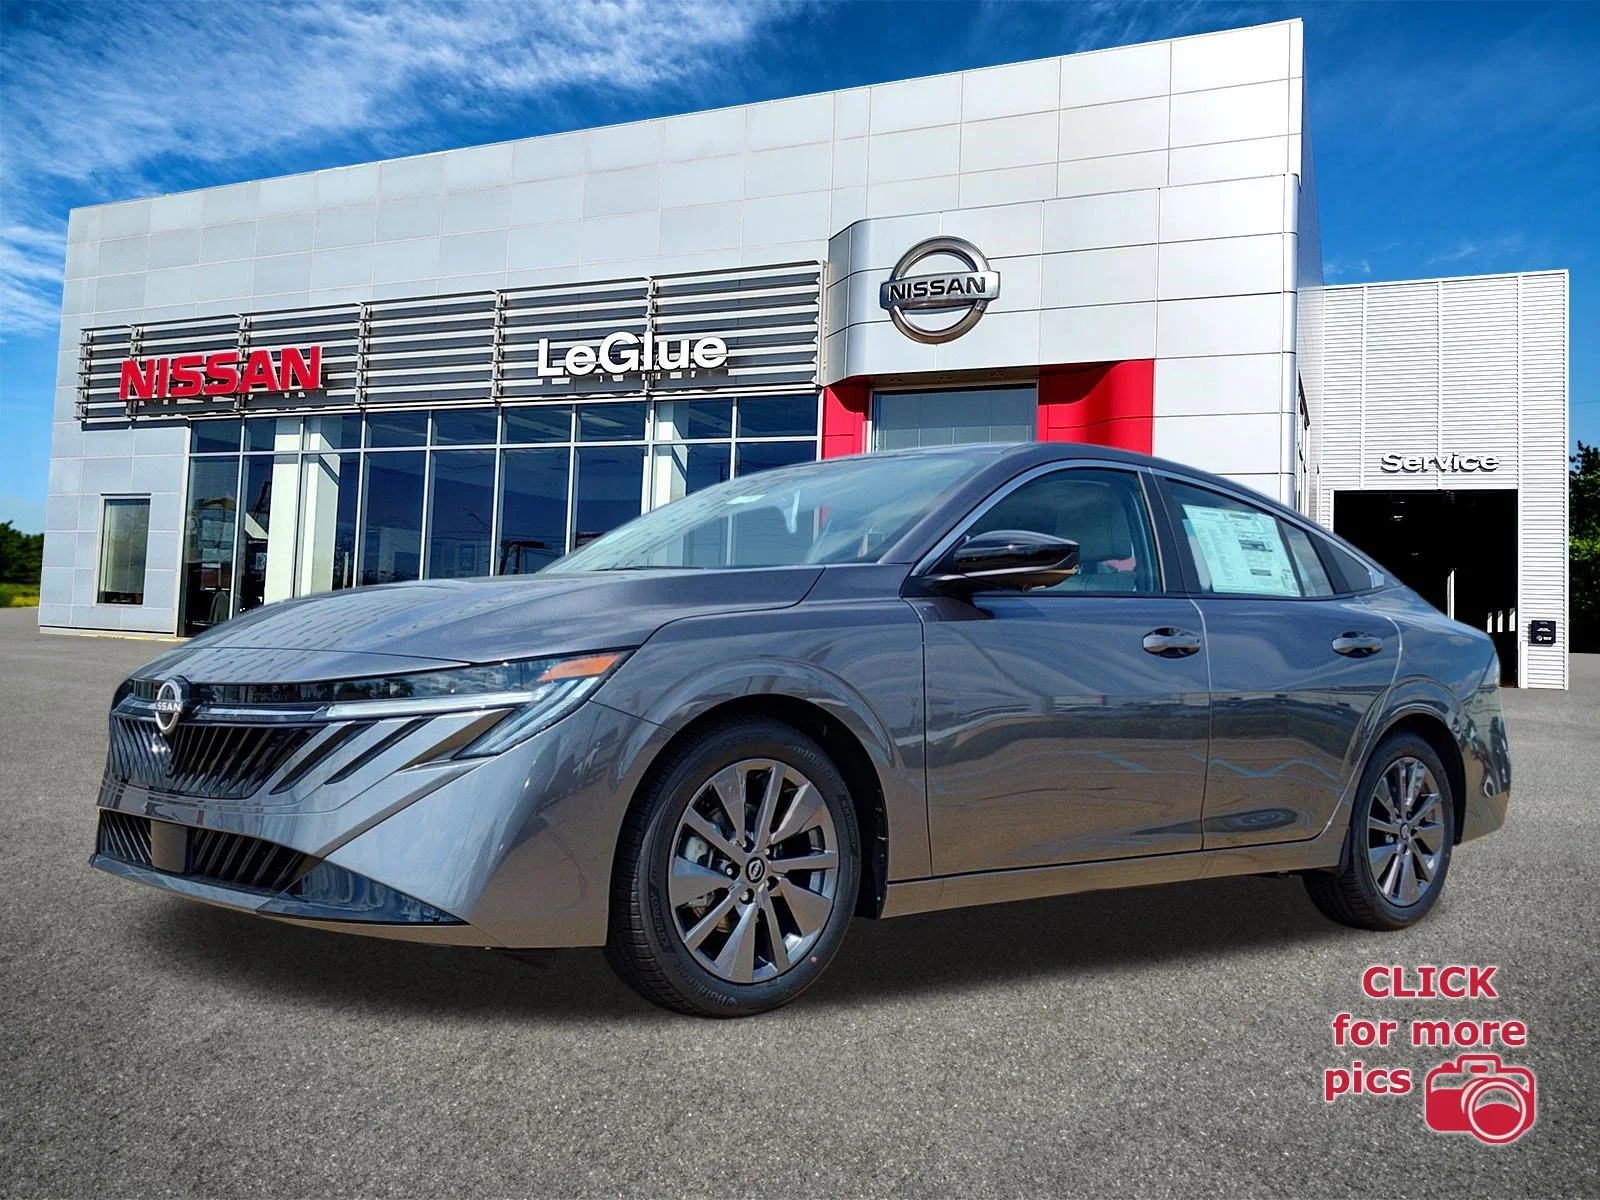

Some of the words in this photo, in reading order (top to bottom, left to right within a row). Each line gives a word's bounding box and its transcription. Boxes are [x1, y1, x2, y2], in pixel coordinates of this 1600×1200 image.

[889, 276, 986, 301] NISSAN
[537, 331, 728, 377] LeGlue
[119, 345, 323, 401] NISSAN
[1381, 451, 1499, 473] Service
[156, 701, 182, 712] SSAN
